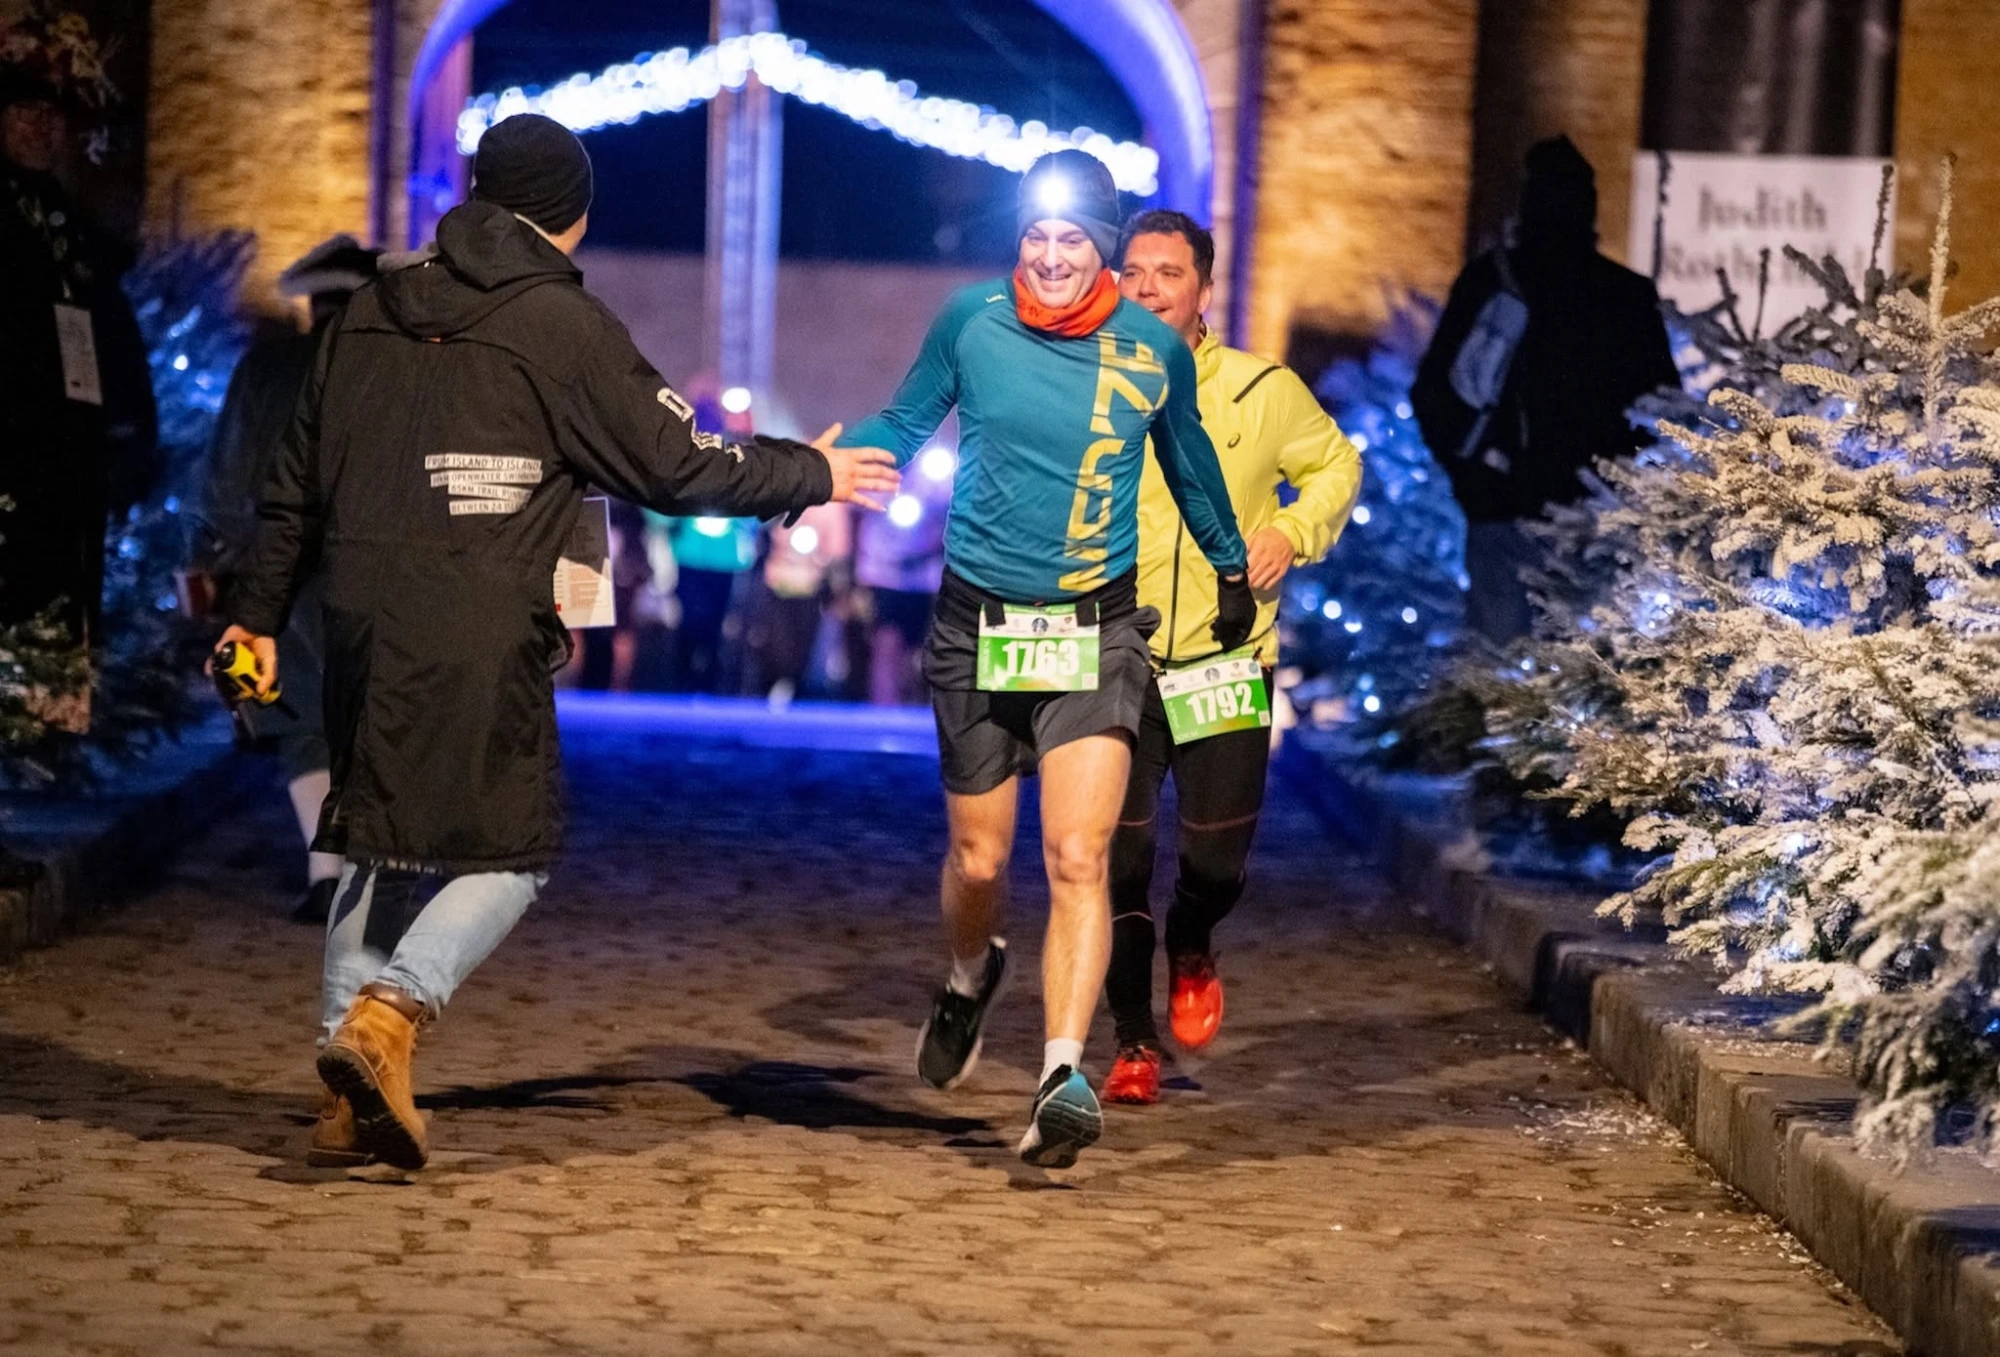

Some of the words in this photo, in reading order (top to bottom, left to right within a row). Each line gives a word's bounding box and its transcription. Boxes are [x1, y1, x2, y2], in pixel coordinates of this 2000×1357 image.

[452, 456, 487, 469] ISLAND
[491, 458, 503, 469] TO
[506, 458, 539, 470] ISLAND
[1002, 639, 1080, 677] 1763
[1185, 682, 1256, 726] 1792
